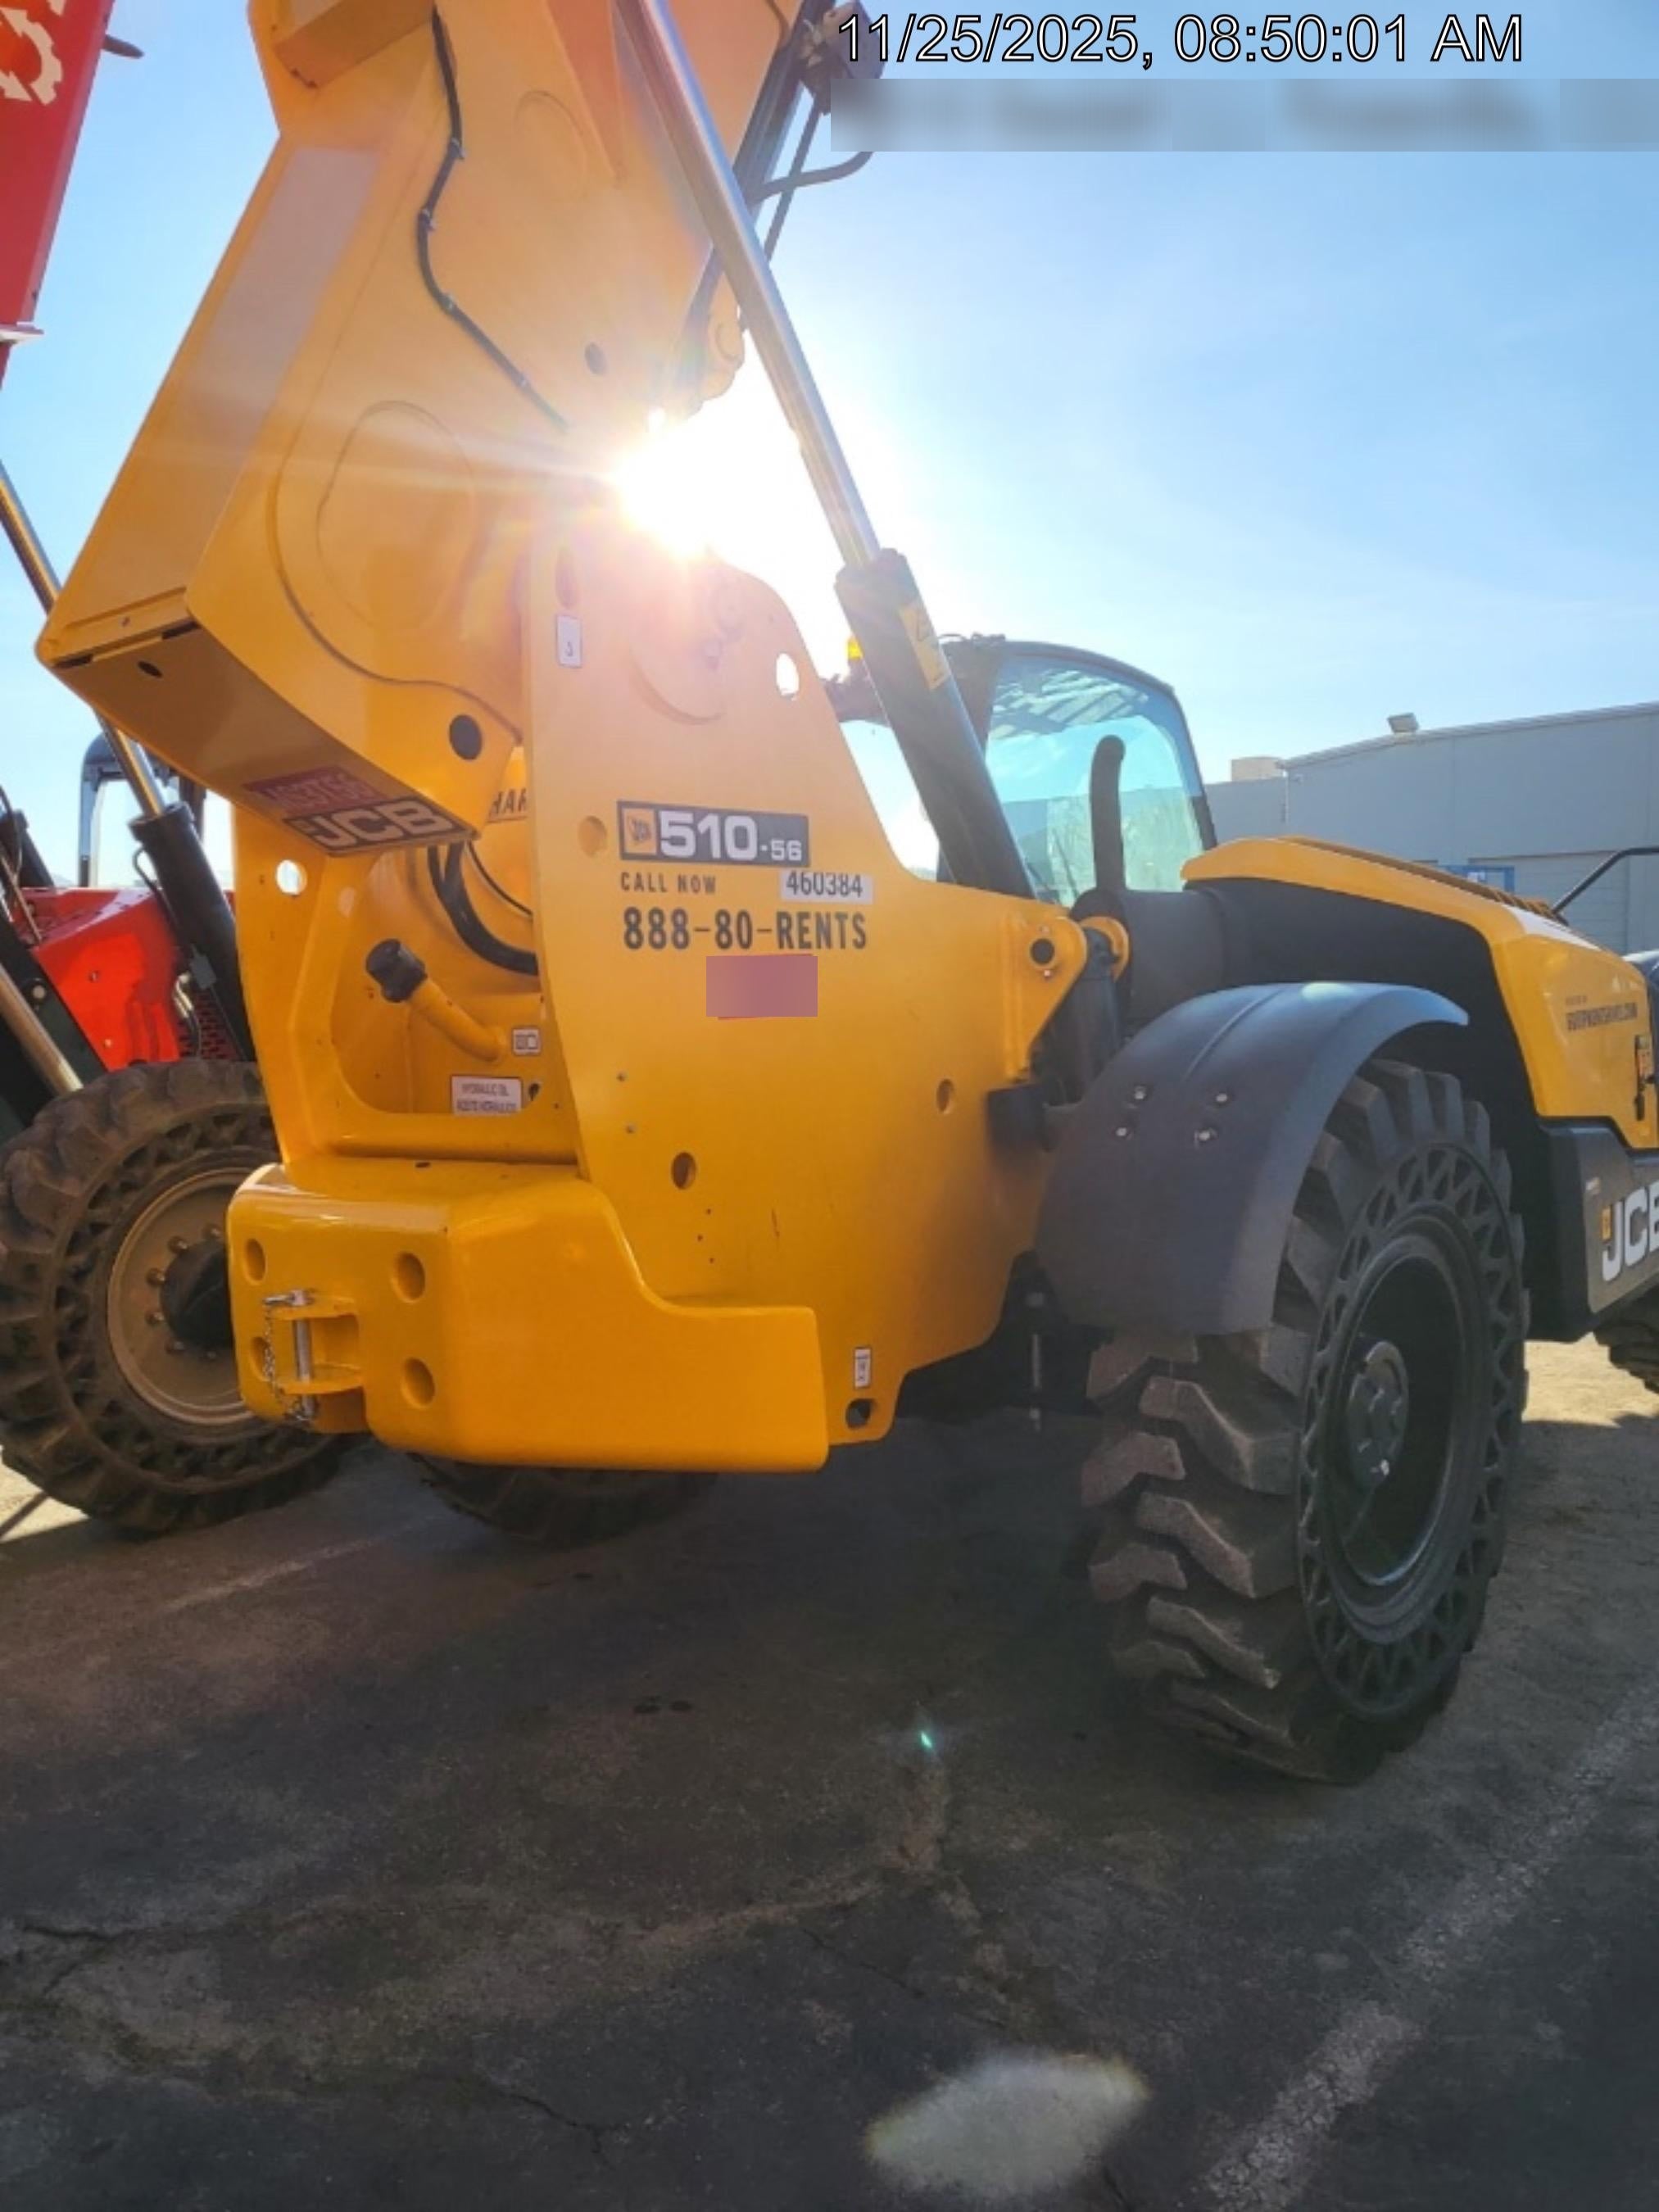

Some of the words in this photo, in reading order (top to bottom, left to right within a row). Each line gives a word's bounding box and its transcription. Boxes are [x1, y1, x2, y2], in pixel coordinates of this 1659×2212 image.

[306, 798, 454, 847] JCB
[620, 872, 668, 893] CALL
[677, 873, 717, 895] NOW
[786, 871, 863, 897] 460384
[623, 906, 868, 950] 888-80-RENTS
